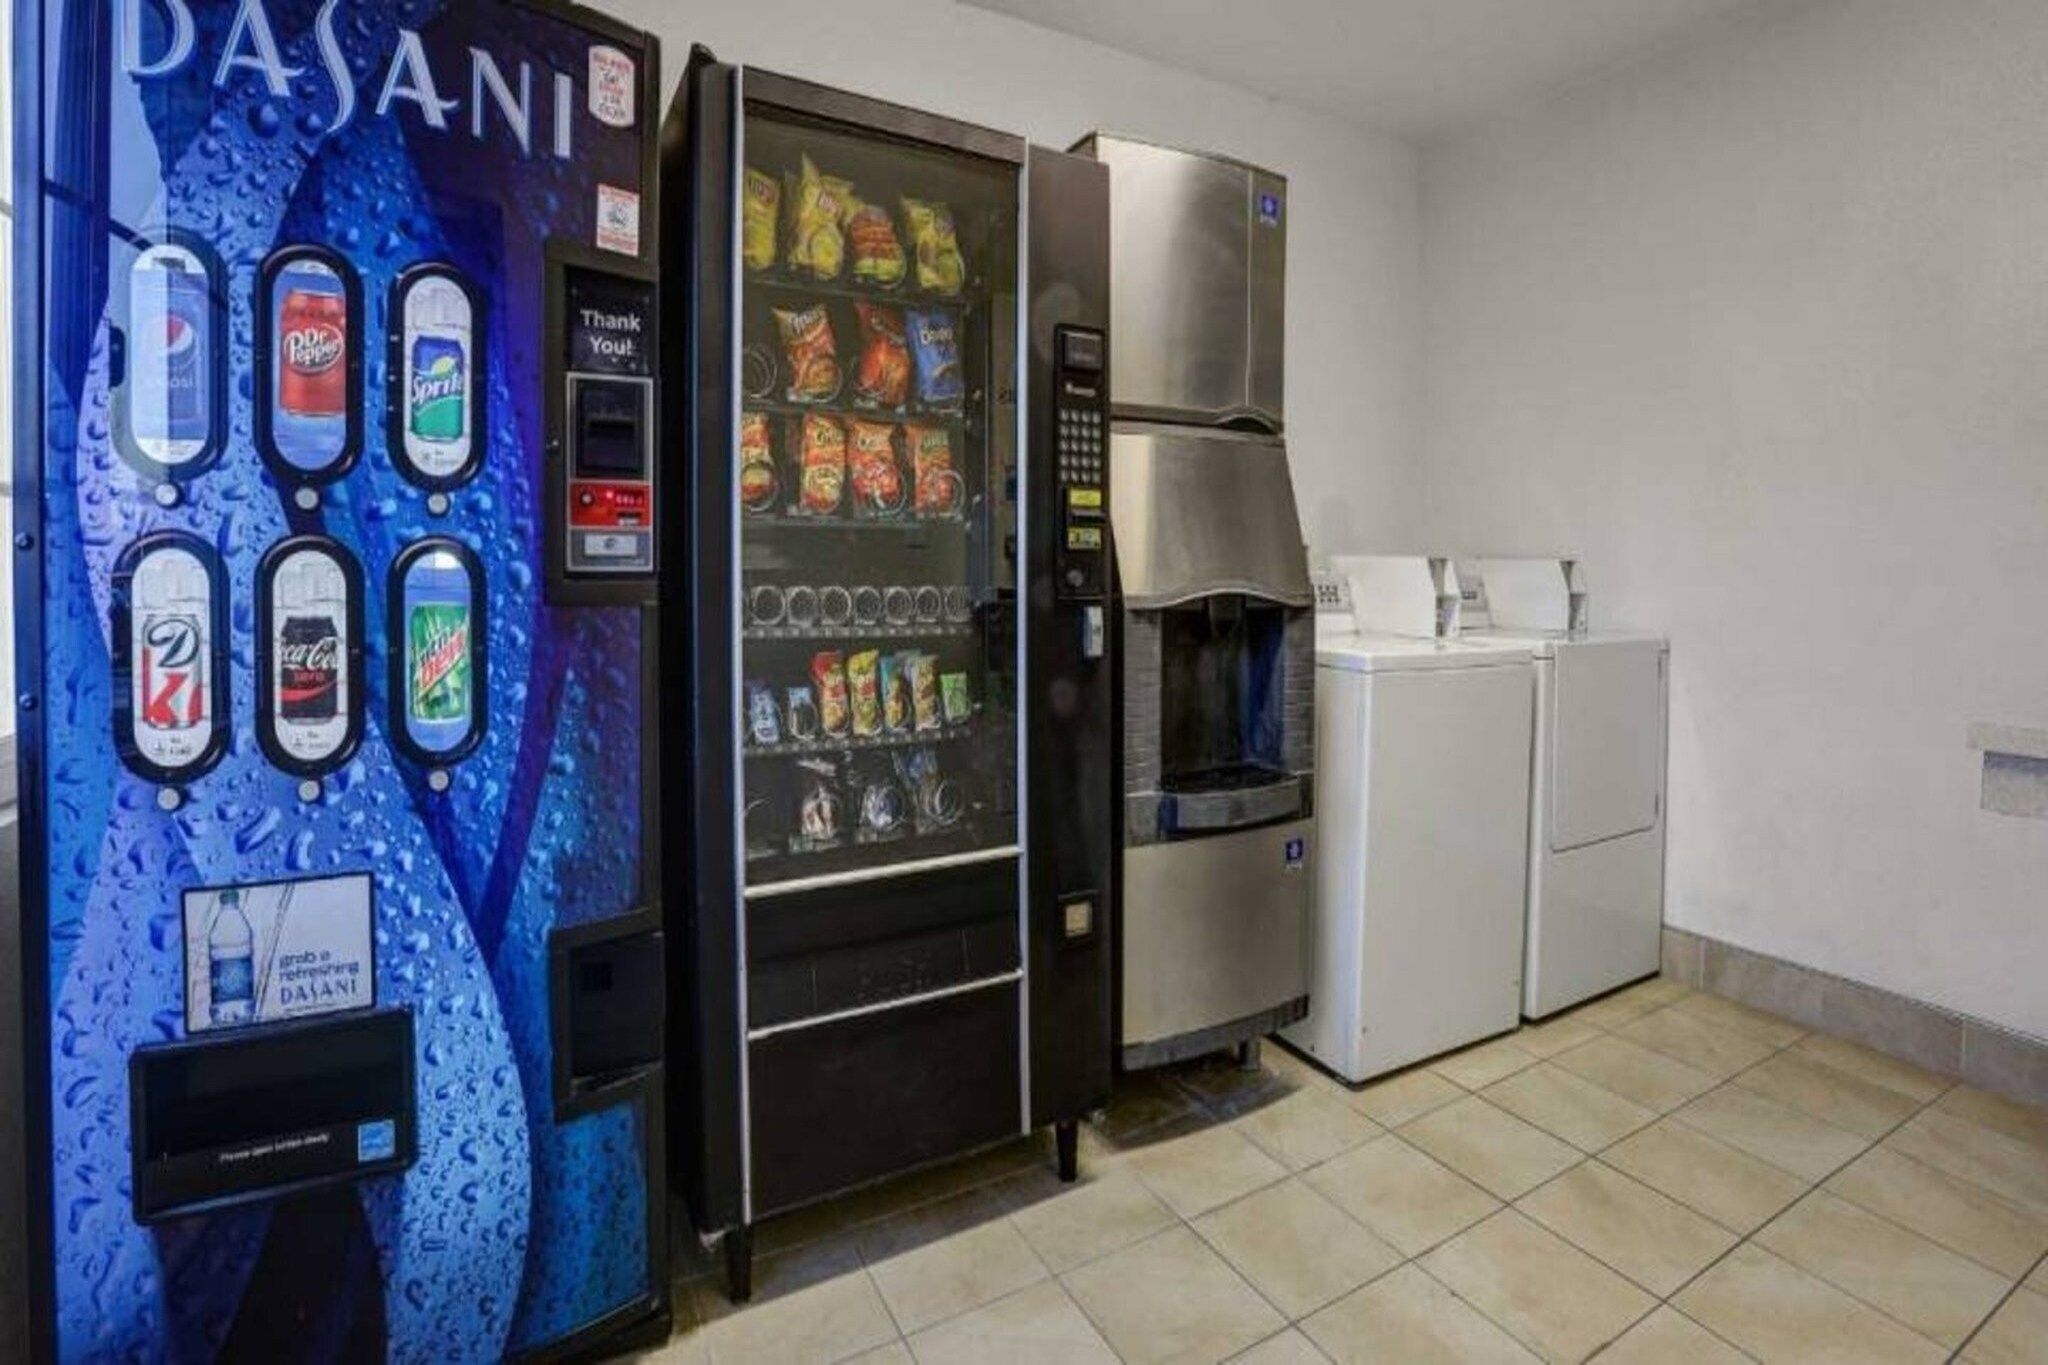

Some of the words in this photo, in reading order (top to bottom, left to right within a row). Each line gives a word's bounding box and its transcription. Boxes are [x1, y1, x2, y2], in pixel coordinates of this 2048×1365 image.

[121, 0, 572, 158] DASANI
[580, 309, 641, 332] Thank
[589, 336, 632, 356] You!
[280, 979, 357, 1006] DASANI
